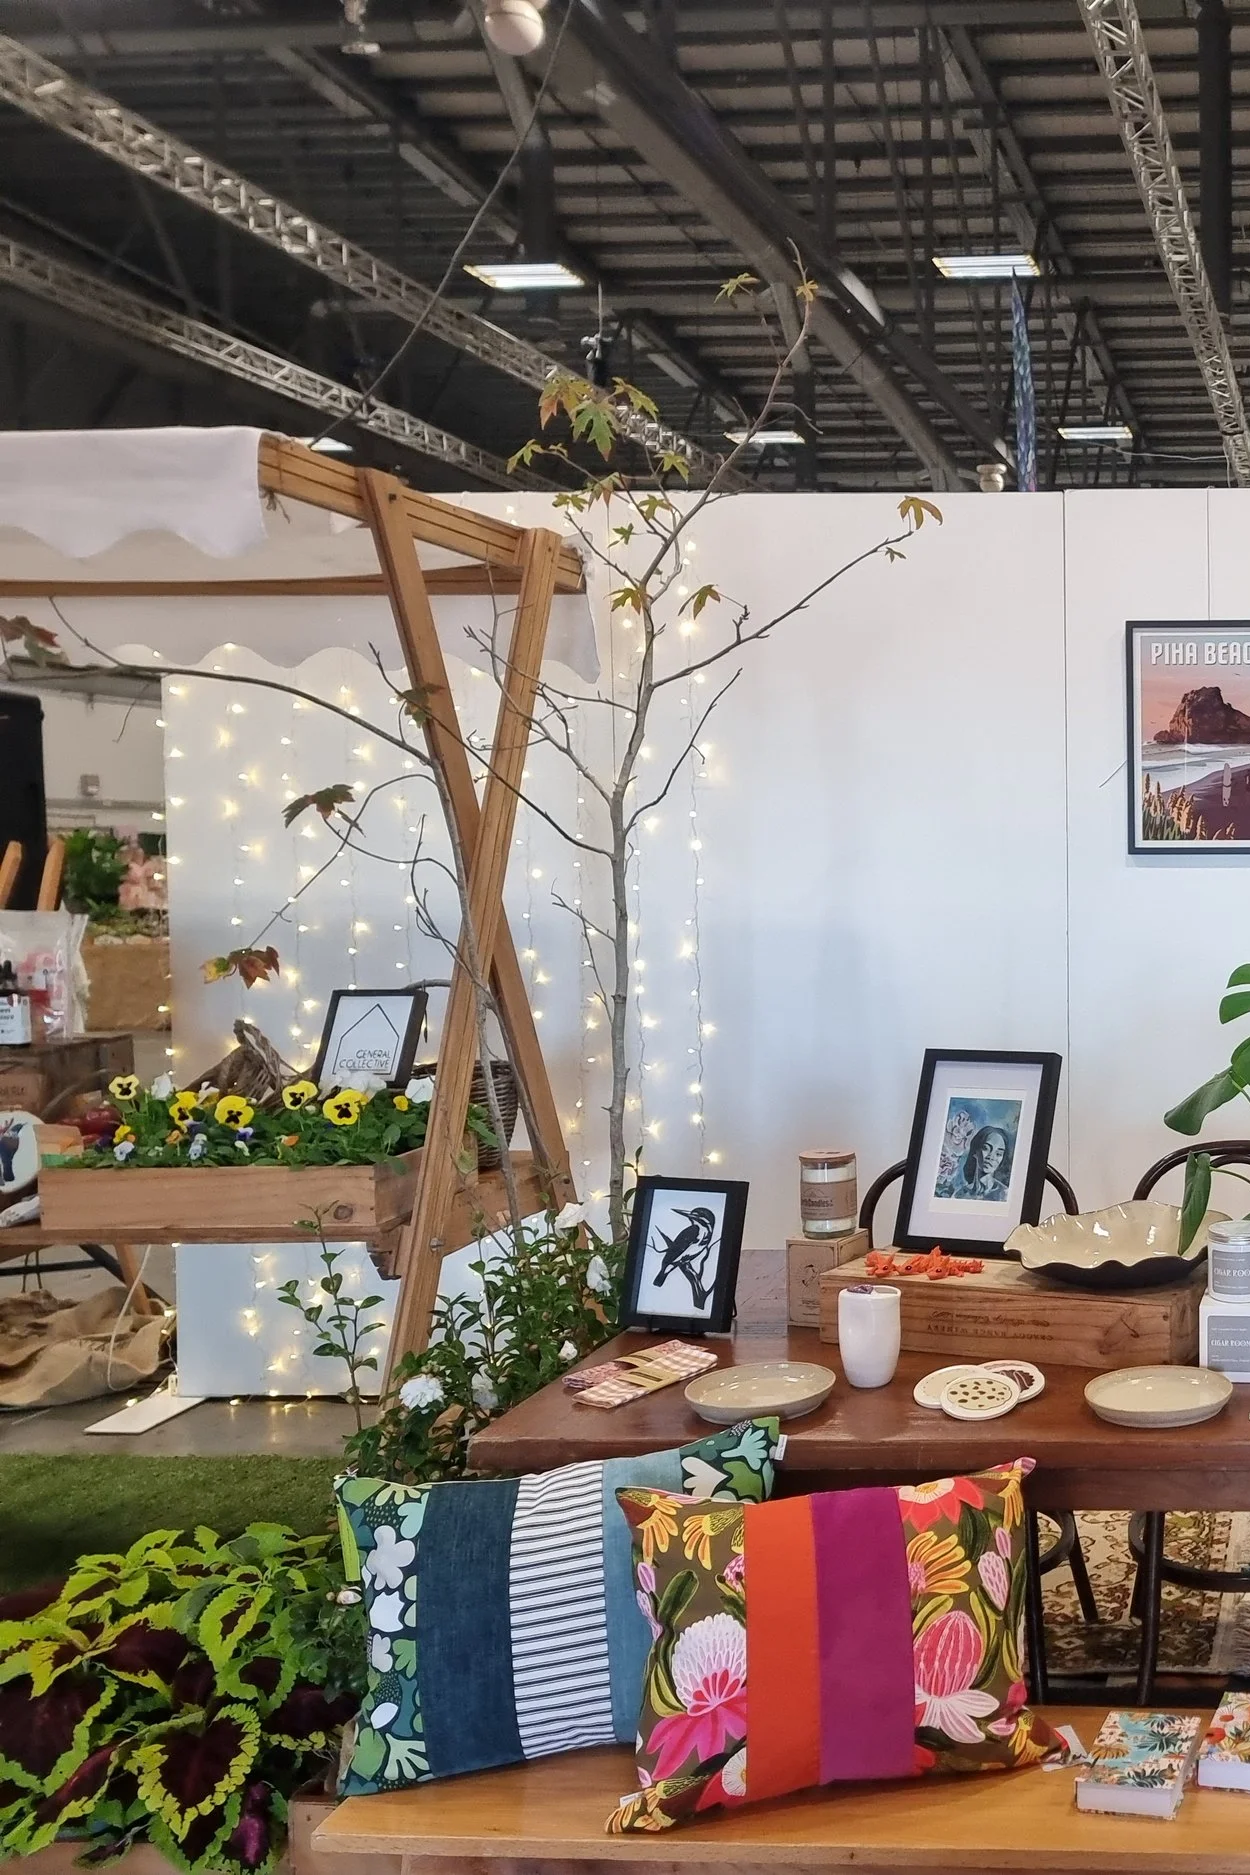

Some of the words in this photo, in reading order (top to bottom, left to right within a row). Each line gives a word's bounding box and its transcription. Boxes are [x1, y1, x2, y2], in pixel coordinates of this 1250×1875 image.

[1151, 642, 1198, 666] PIHA
[356, 1049, 391, 1059] GENERAL
[338, 1059, 389, 1069] COLLECTIVE
